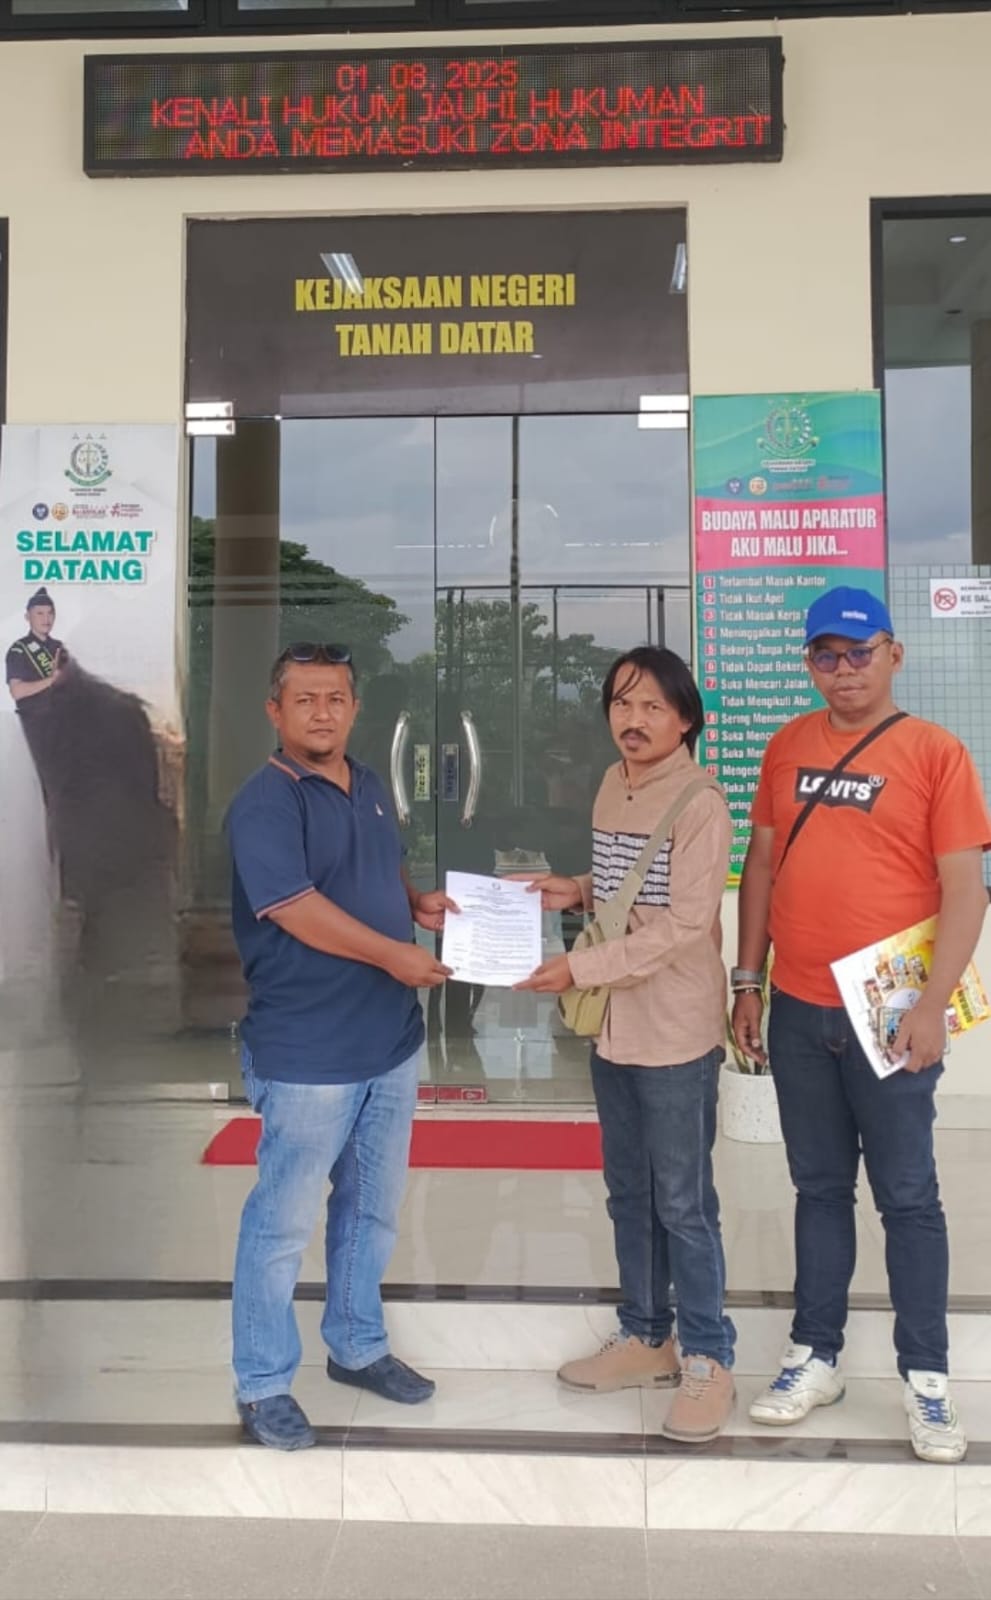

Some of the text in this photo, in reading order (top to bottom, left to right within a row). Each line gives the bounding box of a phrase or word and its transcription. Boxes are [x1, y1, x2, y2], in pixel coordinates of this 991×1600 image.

[151, 85, 704, 129] KENALI HUKUM JAUHI HUKUMAN
[184, 115, 772, 160] ANDA MEMASUKI ZONA INTEGRIT
[295, 273, 576, 311] KEJAKSAAN NEGERI
[335, 321, 534, 356] TANAH DATAR
[702, 508, 877, 531] BUDAYA MALU APARATUR
[16, 530, 153, 552] SELAMAT
[731, 537, 759, 557] AKU
[764, 536, 803, 556] MALU
[24, 559, 143, 581] DATANG
[720, 576, 762, 586] Terlambat
[765, 575, 794, 586] Masuk
[797, 575, 825, 586] Kantor
[720, 594, 742, 604] Tidak
[746, 593, 762, 604] Ikut
[764, 592, 784, 605] Apel
[720, 611, 743, 621] Tidak
[746, 610, 774, 620] Masuk
[778, 609, 801, 622] Kerja
[720, 645, 753, 656] Bekerja
[757, 644, 782, 656] Tanpa
[721, 662, 743, 672] Tidak
[747, 662, 772, 674] Dapat
[722, 680, 742, 690] Suka
[746, 679, 781, 689] Mencari
[785, 679, 808, 689] Jalan
[722, 696, 811, 708] Tidak Mengikuti Alur
[722, 713, 750, 726] Sering
[722, 731, 743, 742] Suka
[722, 748, 744, 759] Suka
